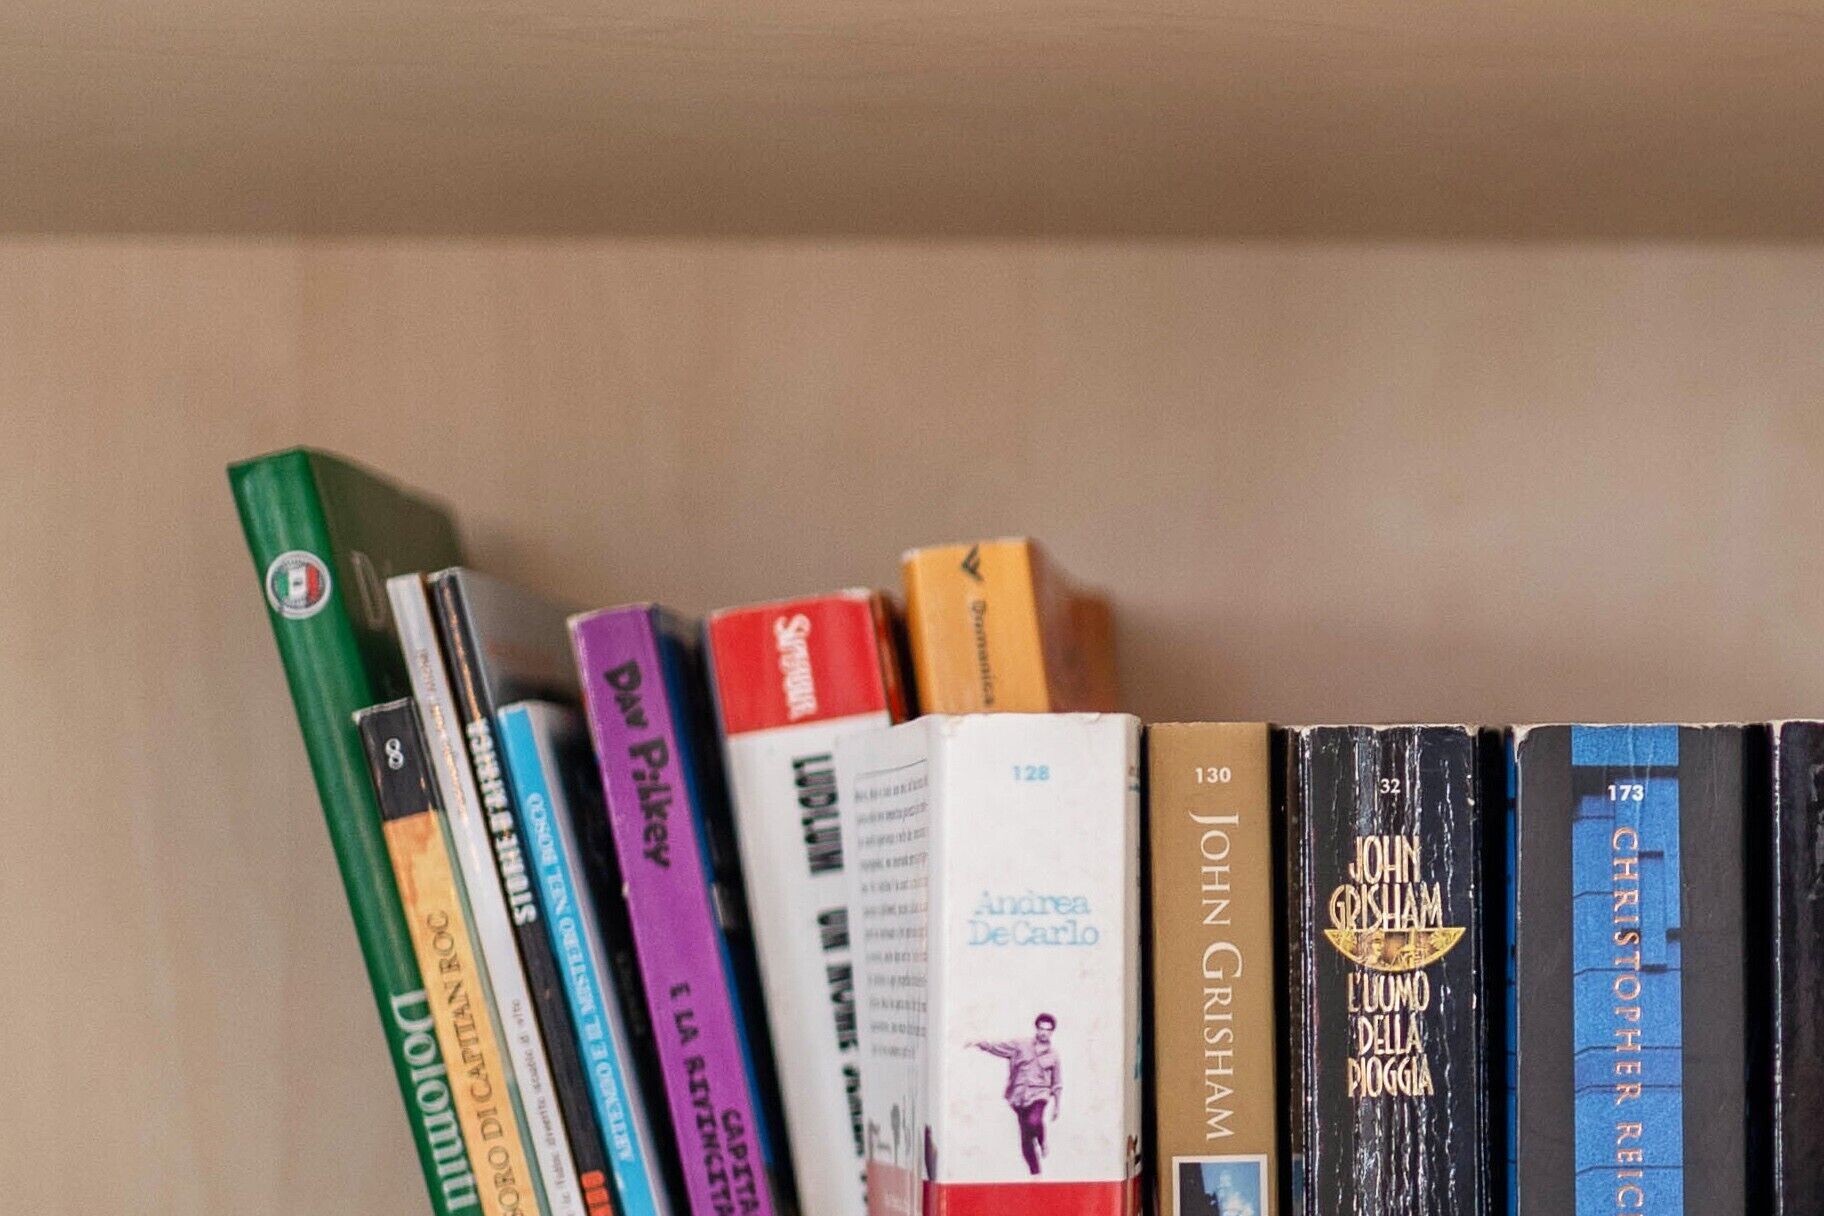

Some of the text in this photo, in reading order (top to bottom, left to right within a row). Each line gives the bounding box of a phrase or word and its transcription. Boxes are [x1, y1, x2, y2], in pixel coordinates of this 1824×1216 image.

[383, 738, 404, 770] 8
[602, 660, 673, 870] Dav Pilkey
[1012, 764, 1050, 783] 128
[1195, 766, 1232, 784] 130
[1380, 777, 1401, 795] 32
[1607, 784, 1645, 802] 173
[790, 751, 849, 875] LUDLUM
[1348, 836, 1421, 884] JOHN
[973, 888, 1093, 917] Andrea
[1328, 883, 1444, 931] GRISHAM
[424, 907, 462, 976] ROC
[1189, 809, 1243, 1141] JOHN GRISHAM
[1611, 826, 1643, 1106] CHRISTOPHER
[668, 981, 691, 1000] E
[1347, 970, 1431, 1014] L'UOMO
[442, 978, 494, 1106] CAPITAN
[672, 1007, 700, 1045] LA
[1357, 1012, 1424, 1055] DELLA
[1346, 1054, 1434, 1098] PIOGGIA
[387, 985, 482, 1214] Dolomiti
[475, 1104, 505, 1142] DI
